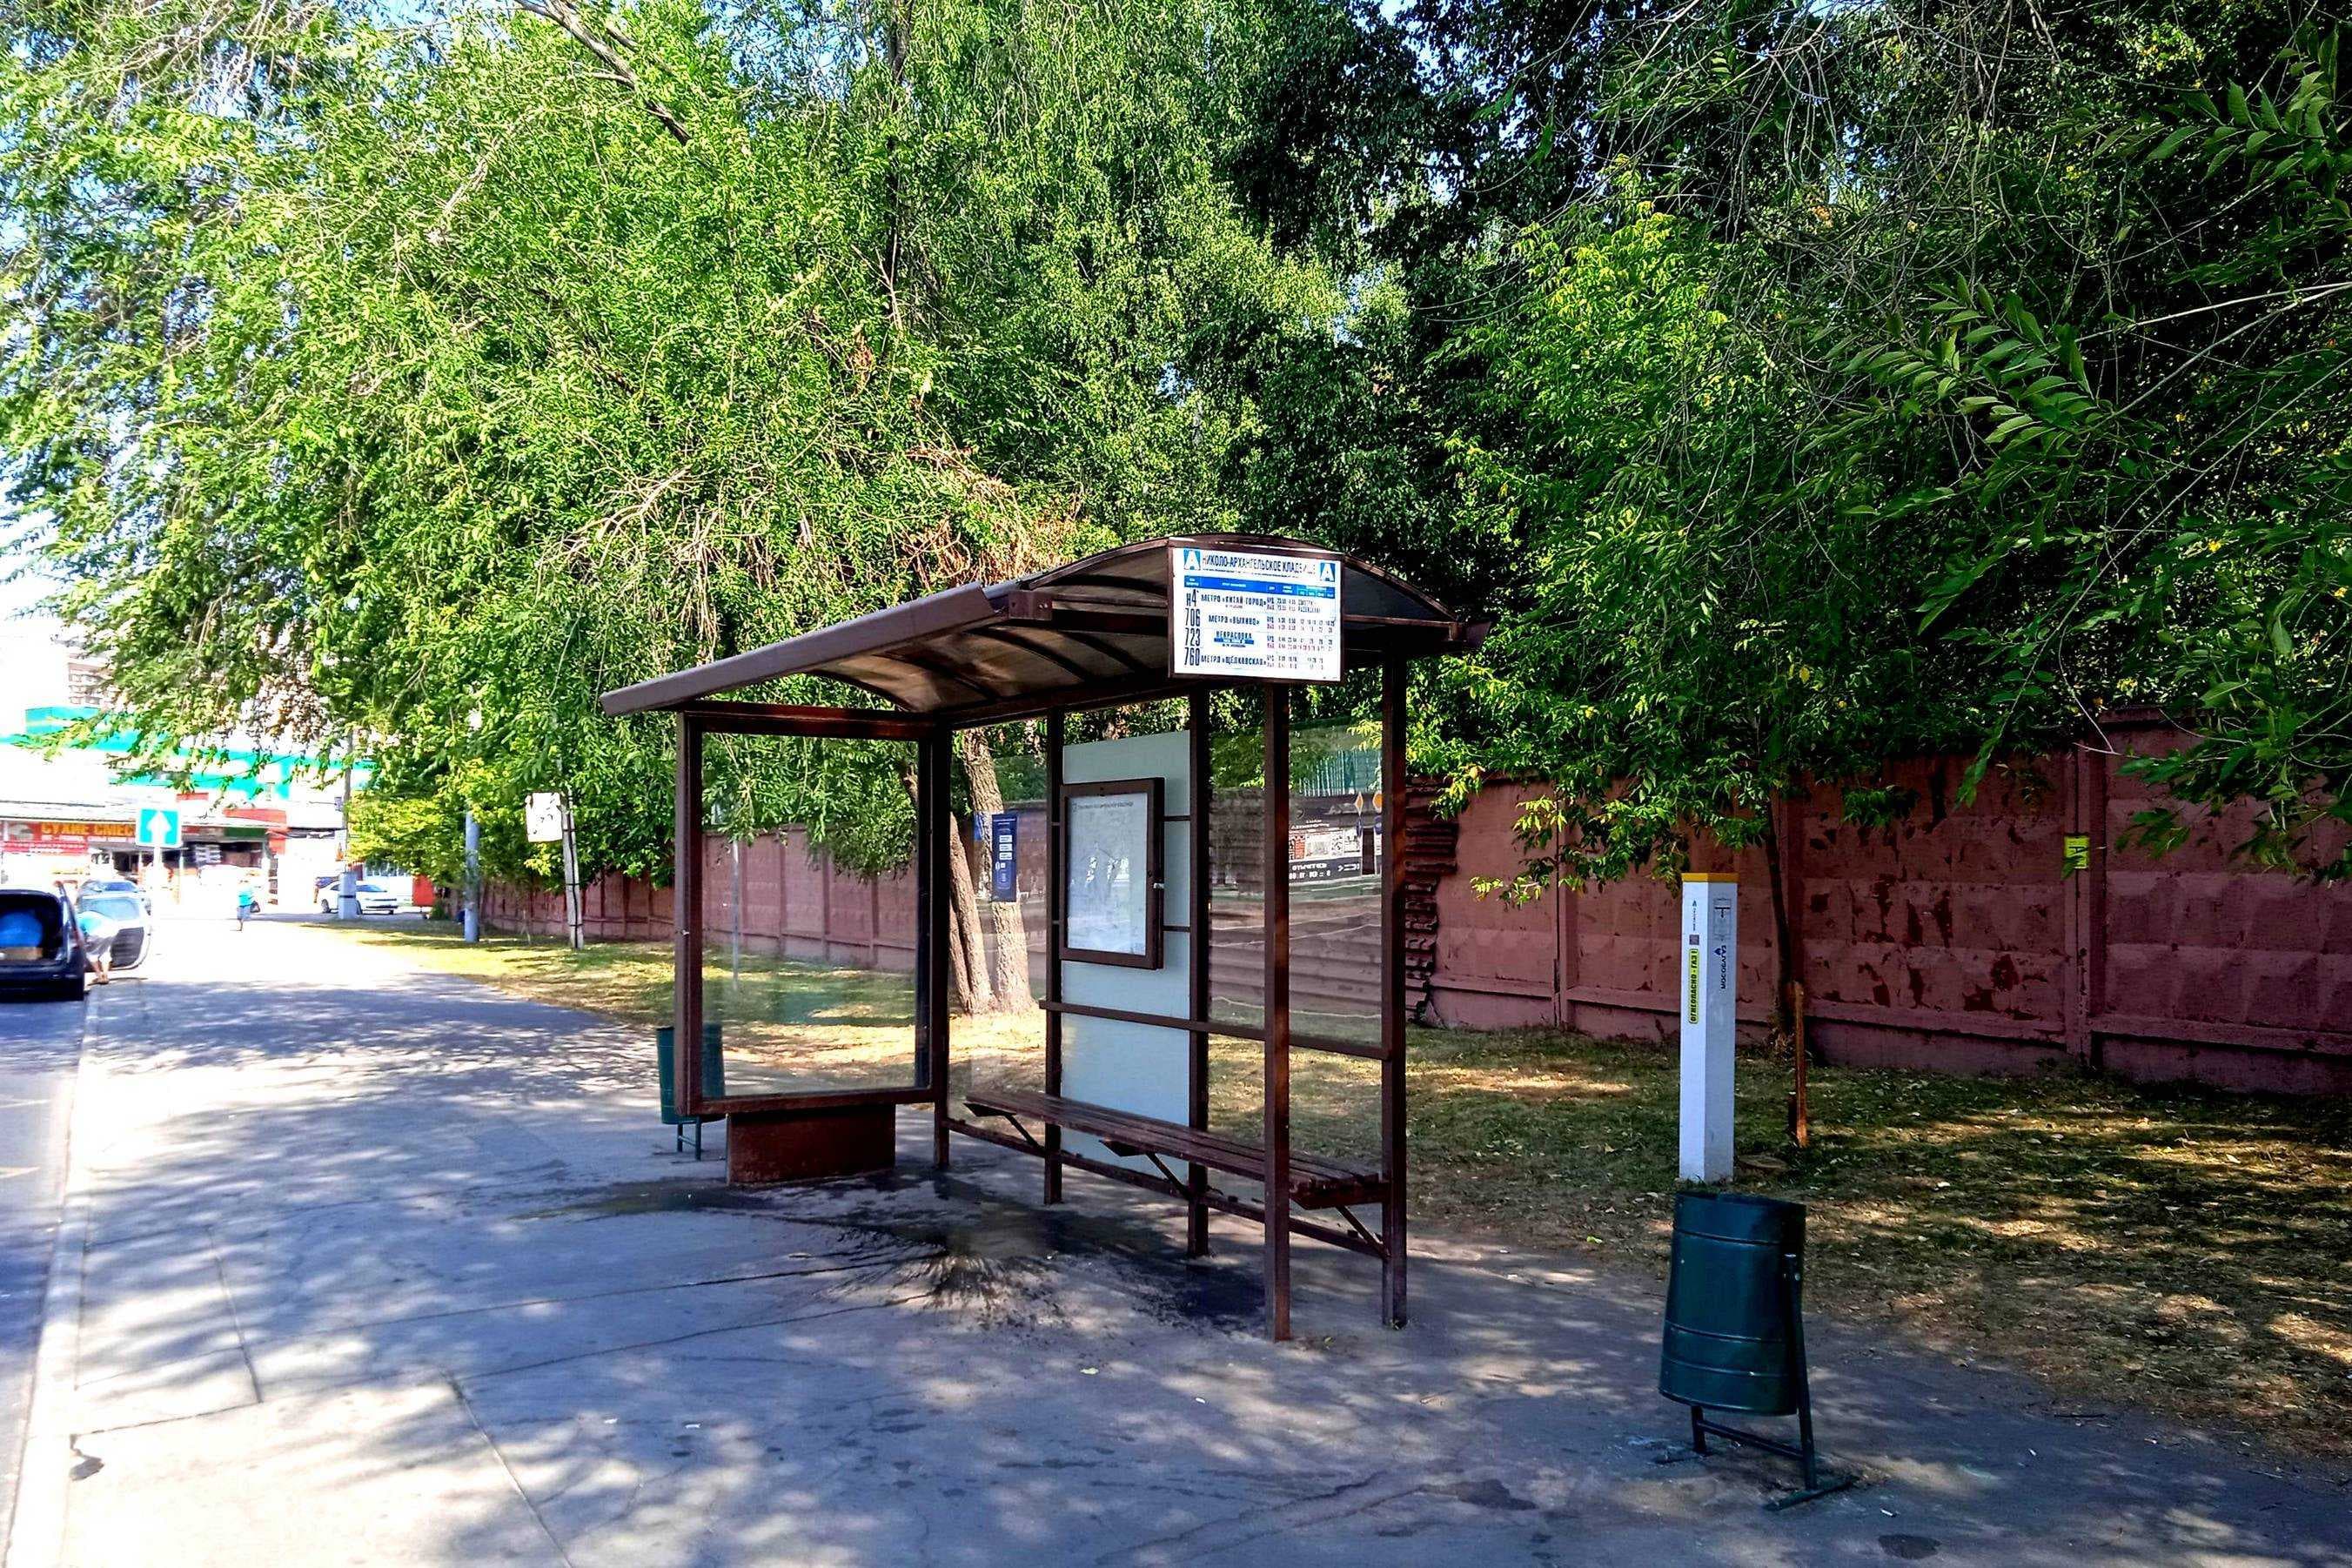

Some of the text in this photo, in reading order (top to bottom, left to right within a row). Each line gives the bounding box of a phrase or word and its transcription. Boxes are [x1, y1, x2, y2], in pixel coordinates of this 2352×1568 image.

[1201, 593, 1221, 602] МЕТРО
[1185, 607, 1201, 627] 706
[1185, 627, 1201, 647] 723
[1184, 647, 1201, 667] 760
[94, 823, 135, 836] СМЕС
